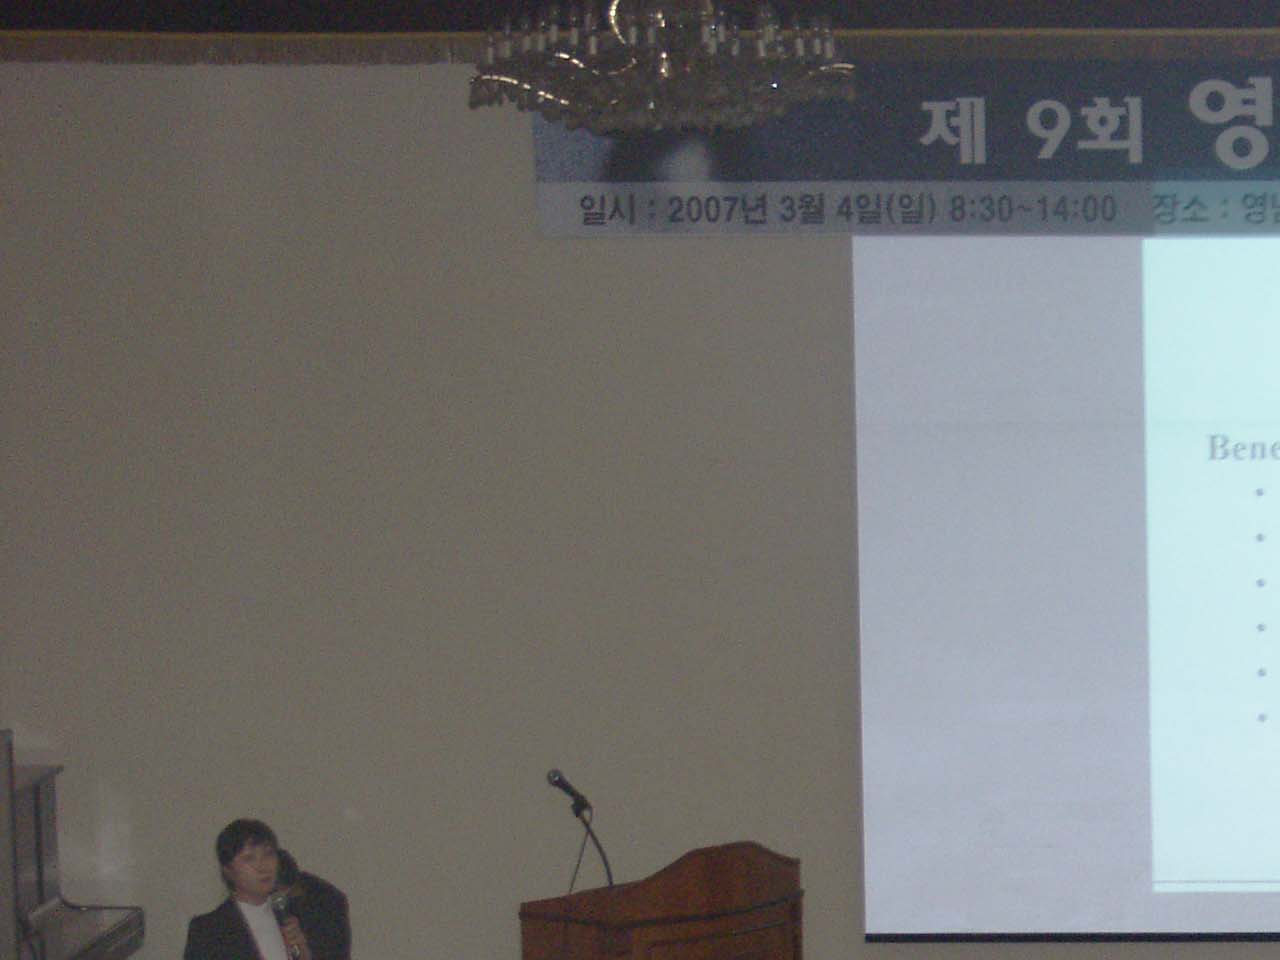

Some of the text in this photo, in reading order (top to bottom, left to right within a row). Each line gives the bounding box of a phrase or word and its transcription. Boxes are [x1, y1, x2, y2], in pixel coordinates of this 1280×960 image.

[919, 96, 987, 165] 제
[1025, 96, 1144, 164] 9회
[667, 193, 768, 226] 2007년
[780, 192, 826, 225] 3월
[836, 192, 937, 226] 4일(일)
[949, 193, 1118, 224] 8:30~14:00
